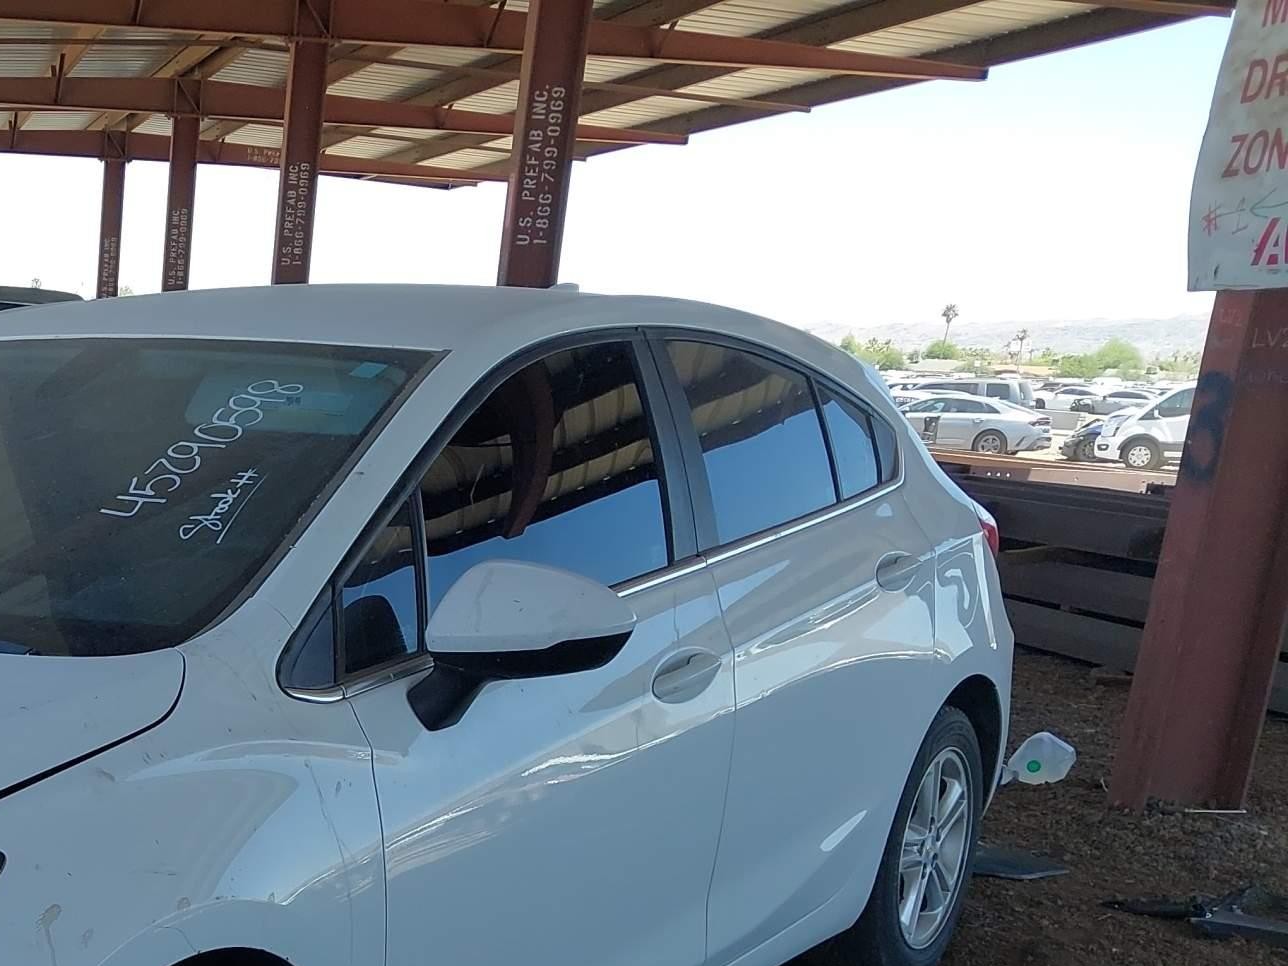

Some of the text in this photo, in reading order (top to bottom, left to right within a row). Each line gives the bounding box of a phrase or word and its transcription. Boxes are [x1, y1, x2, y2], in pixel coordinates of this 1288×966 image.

[283, 190, 298, 237] PREFAB
[516, 84, 550, 245] U.S. PREFAB INC.
[533, 86, 566, 244] 1-866-799-0969
[99, 379, 304, 518] 45290598
